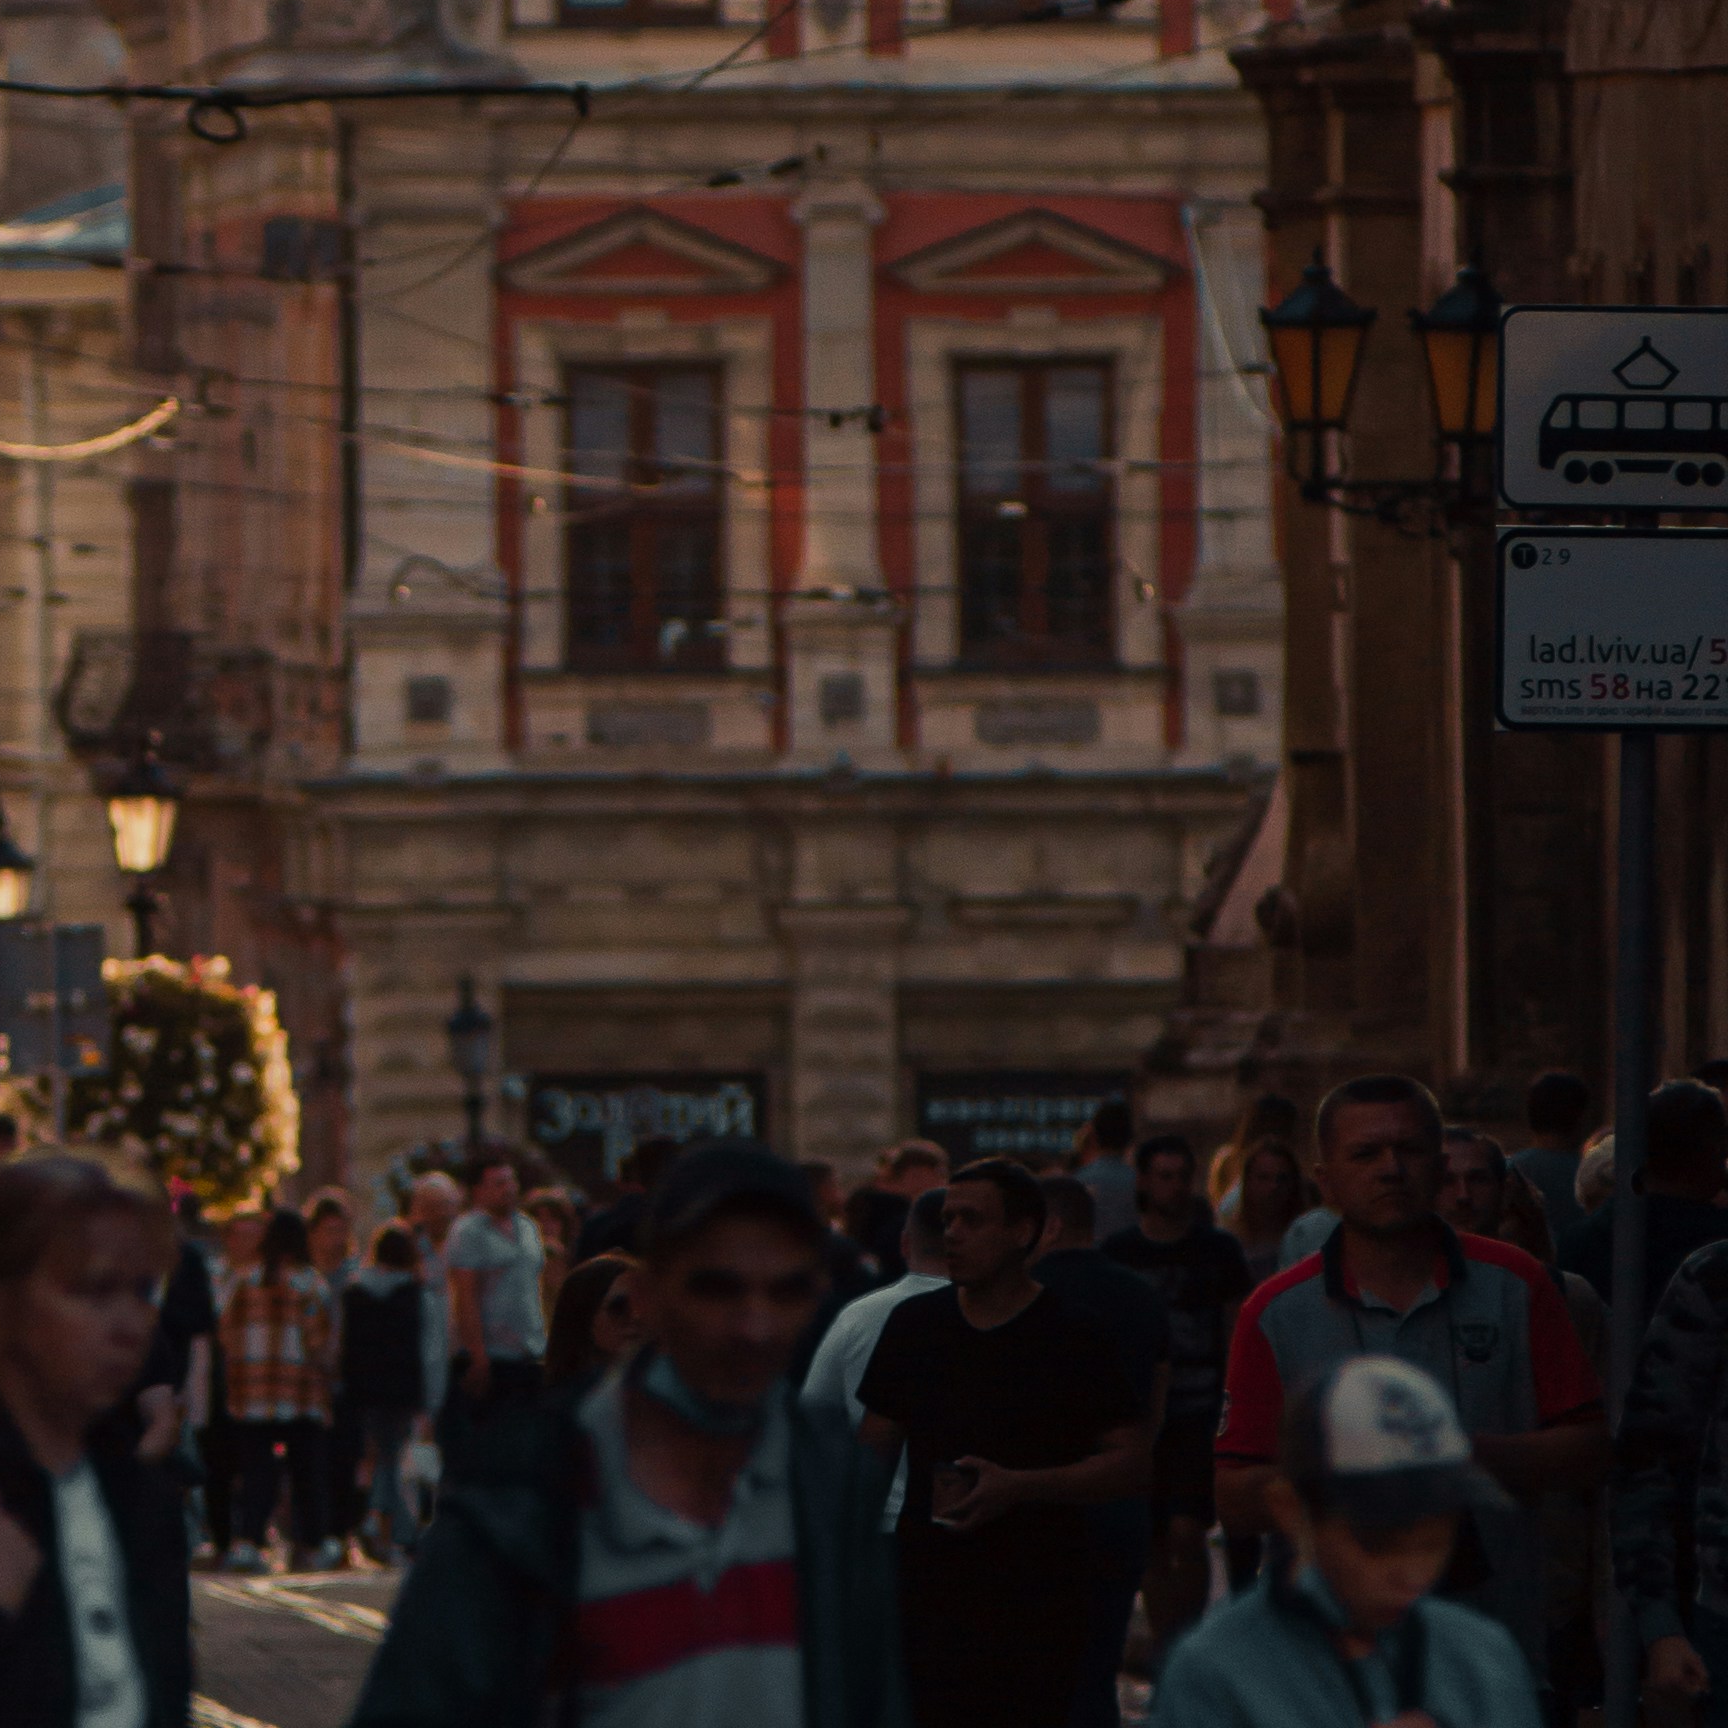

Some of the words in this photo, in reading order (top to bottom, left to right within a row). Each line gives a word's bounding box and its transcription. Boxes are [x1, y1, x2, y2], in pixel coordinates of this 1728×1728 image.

[1541, 548, 1553, 565] 2
[1558, 548, 1571, 565] 9
[1529, 634, 1703, 672] lad.lviv.ua/
[1520, 678, 1582, 700] sms
[1590, 673, 1630, 700] 58
[1636, 679, 1673, 700] на
